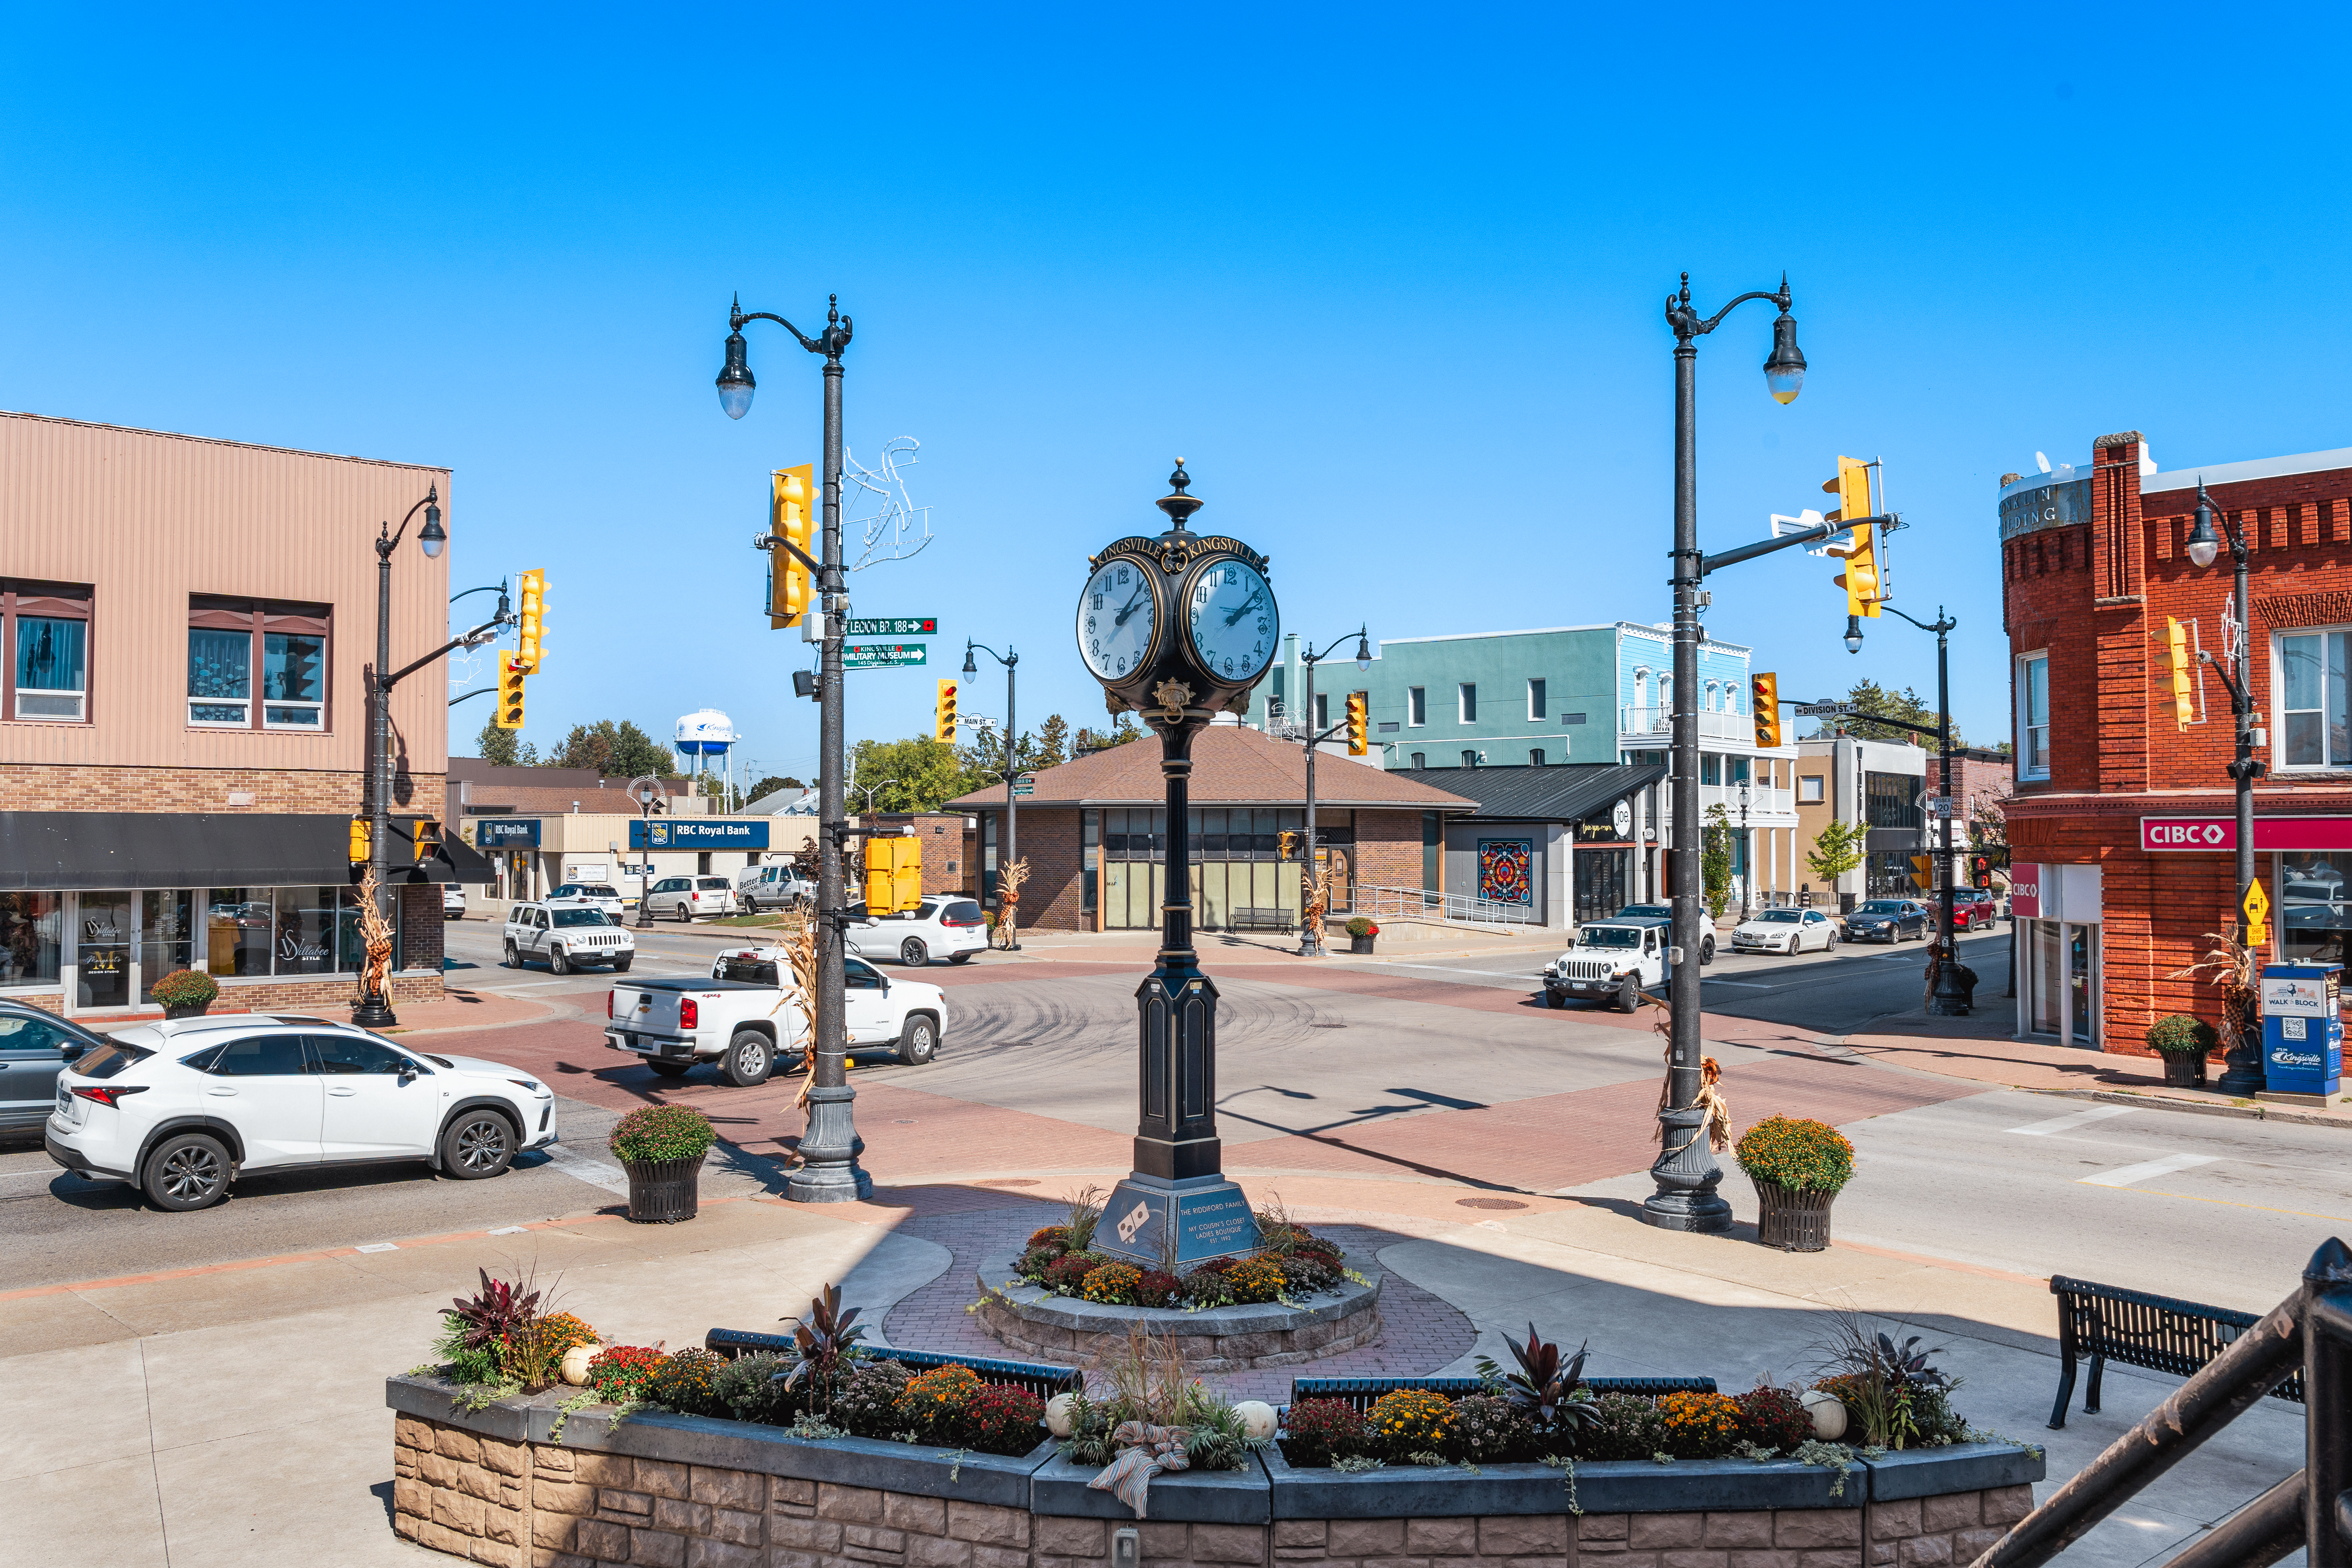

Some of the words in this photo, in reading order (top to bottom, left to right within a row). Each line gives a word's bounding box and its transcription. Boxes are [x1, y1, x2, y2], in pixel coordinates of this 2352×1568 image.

[1096, 538, 1162, 566] KINGSVILLE
[1187, 537, 1261, 568] KINGSVILLE
[1105, 575, 1112, 592] 11
[1117, 566, 1129, 585] 12
[1136, 571, 1140, 588] 1
[1209, 570, 1217, 587] 11
[1224, 567, 1237, 585] 12
[1245, 576, 1249, 592] 1
[1093, 593, 1103, 610] 10
[1144, 585, 1152, 603] 2
[1196, 586, 1207, 603] 10
[1253, 592, 1263, 611] 2
[1088, 616, 1096, 634] 9
[1147, 608, 1154, 626] 3
[1191, 608, 1199, 626] 9
[850, 621, 877, 633] LEGION
[880, 621, 891, 633] BR.
[894, 620, 907, 632] 188
[1258, 617, 1269, 635] 3
[1092, 639, 1099, 656] 8
[1143, 633, 1150, 646] 4
[1195, 632, 1203, 650] 8
[845, 652, 876, 661] MILITARY
[1253, 640, 1263, 657] 4
[1102, 653, 1110, 671] 7
[1118, 657, 1125, 675] 6
[1132, 651, 1140, 667] 5
[1207, 650, 1216, 667] 7
[1223, 657, 1233, 675] 6
[1239, 654, 1250, 672] 5
[1804, 706, 1836, 714] DIVISION
[707, 723, 731, 733] Kingsville
[1616, 808, 1629, 826] joe.
[495, 825, 504, 834] RBC
[505, 825, 516, 837] Royal
[517, 824, 528, 834] Bank
[677, 825, 696, 835] RBC
[699, 825, 725, 837] Royal
[727, 825, 750, 835] Bank
[2150, 826, 2200, 843] CIBC
[740, 877, 759, 889] Better
[2013, 884, 2029, 896] CIBC
[93, 951, 115, 969] M
[2283, 1053, 2321, 1064] Kingsville
[1193, 1204, 1223, 1214] RIDDIFORD
[1225, 1200, 1244, 1209] FAMILY
[1196, 1231, 1214, 1239] LADIES
[1215, 1226, 1241, 1236] BOUTIQUE
[1199, 1221, 1224, 1230] COUSIN'S
[1226, 1218, 1245, 1226] CLOSET
